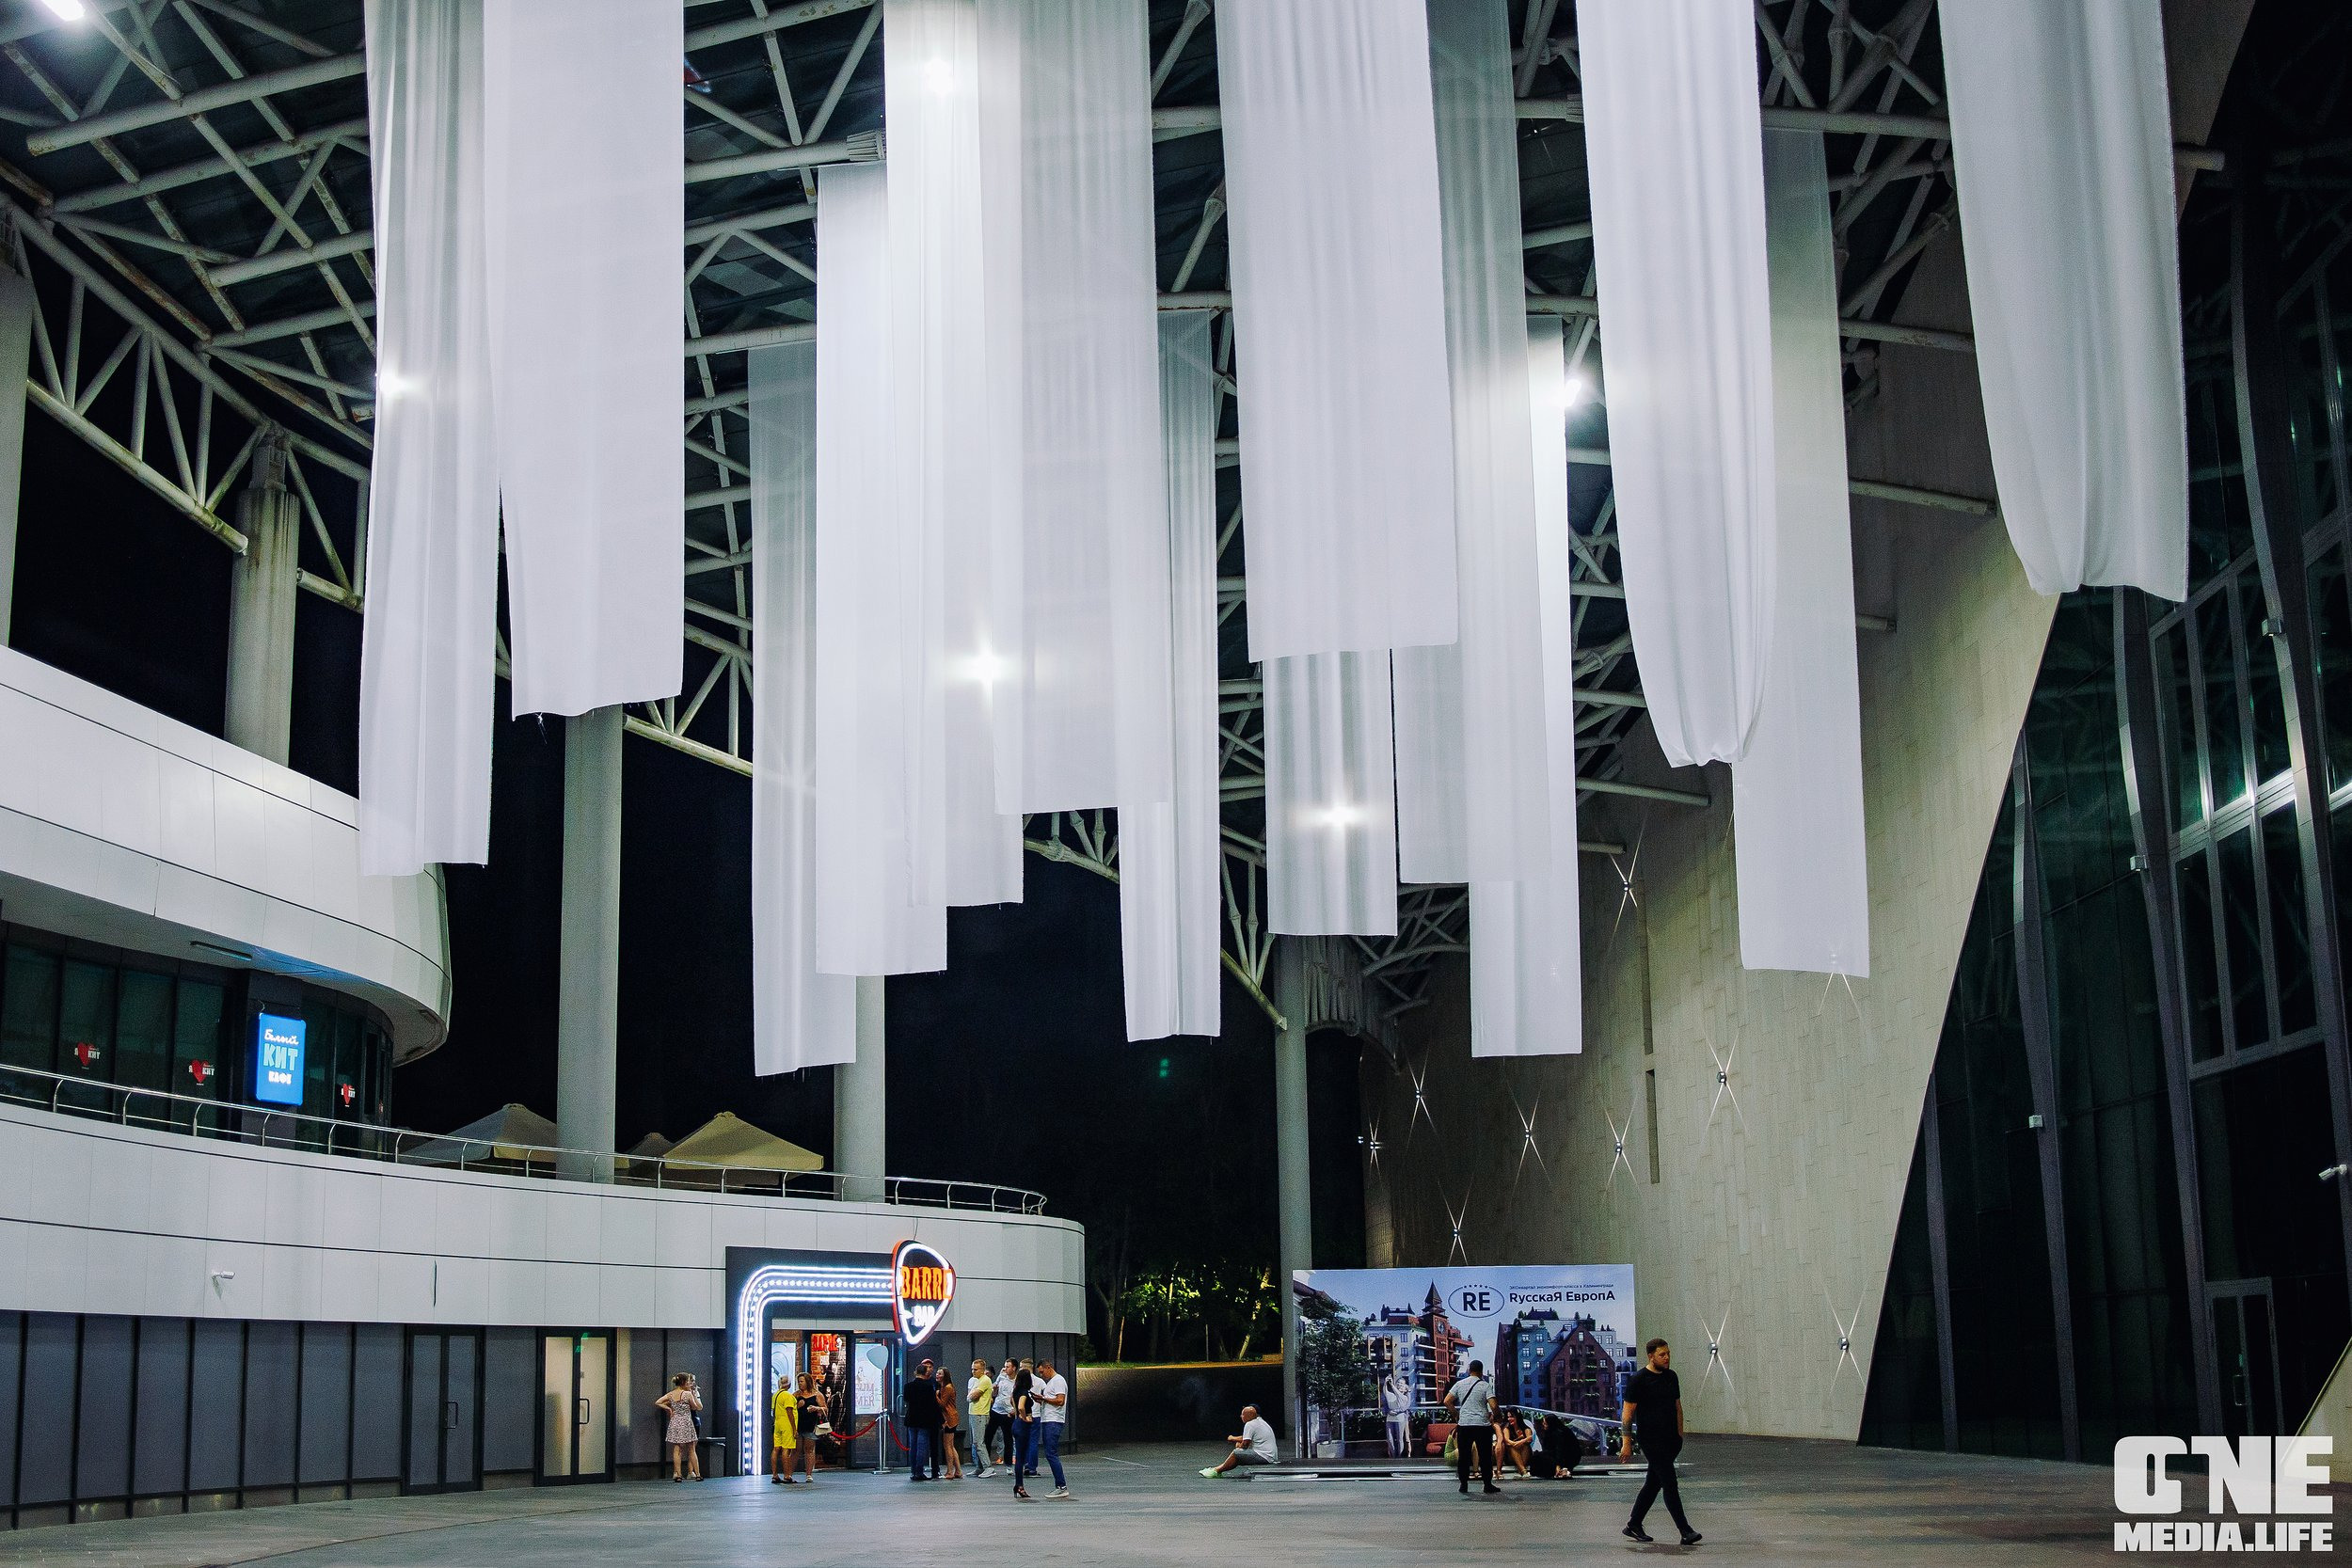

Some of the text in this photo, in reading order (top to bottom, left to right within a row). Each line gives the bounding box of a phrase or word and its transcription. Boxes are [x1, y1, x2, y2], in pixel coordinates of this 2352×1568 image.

[264, 1029, 299, 1045] Белый
[263, 1043, 298, 1071] КИТ
[1462, 1291, 1491, 1312] RE
